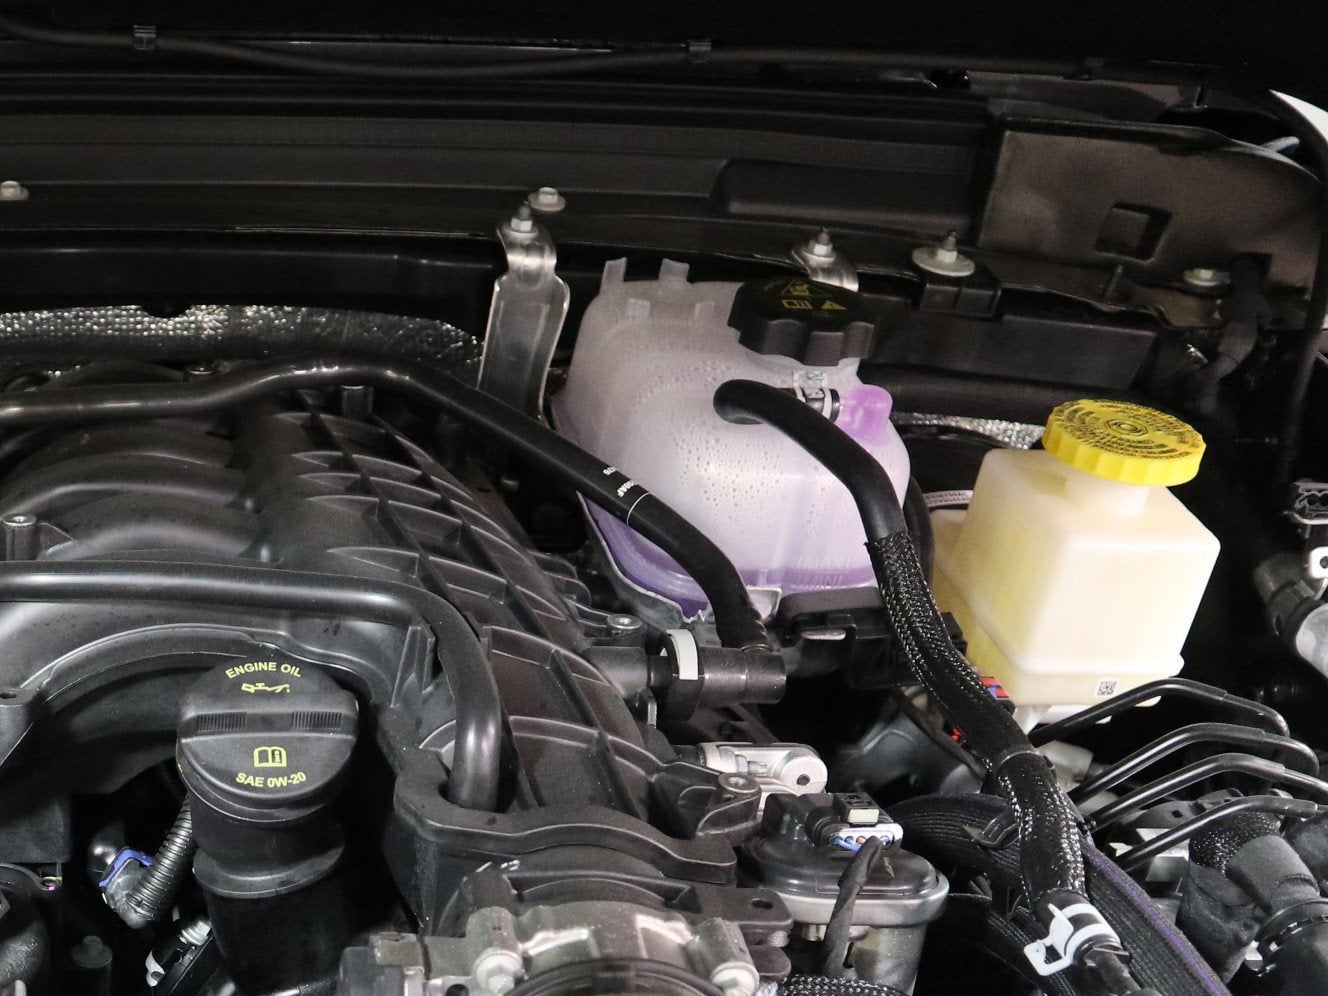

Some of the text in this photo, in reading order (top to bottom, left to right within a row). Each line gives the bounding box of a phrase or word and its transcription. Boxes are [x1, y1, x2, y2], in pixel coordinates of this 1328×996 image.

[225, 661, 303, 679] ENGINE OIL
[235, 771, 307, 788] SAE 0W-20
